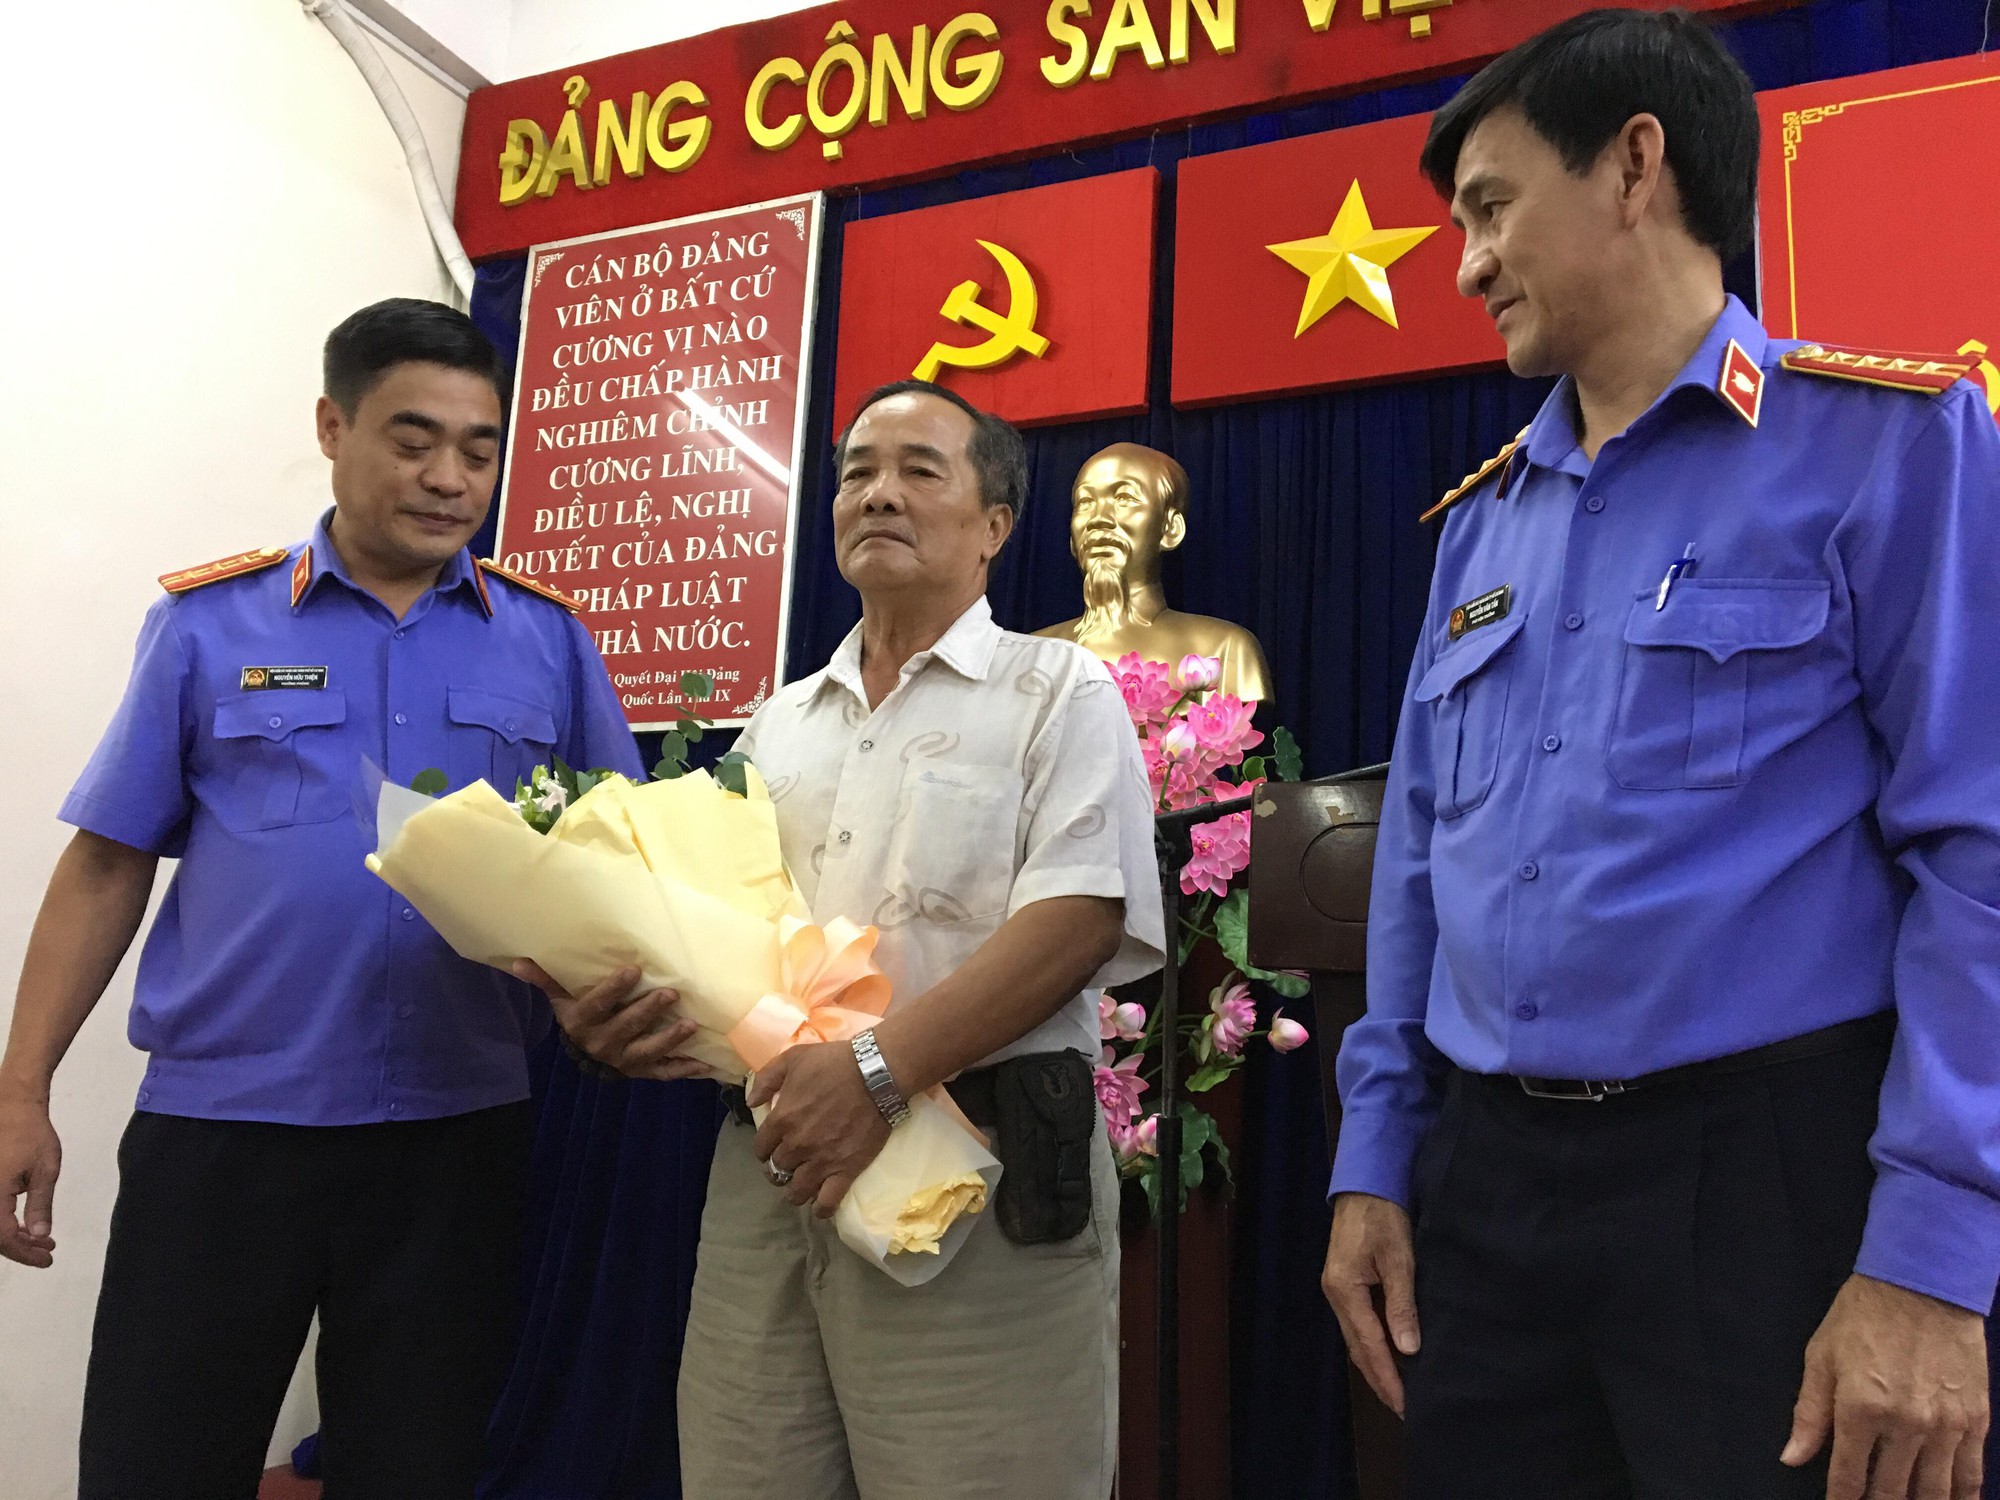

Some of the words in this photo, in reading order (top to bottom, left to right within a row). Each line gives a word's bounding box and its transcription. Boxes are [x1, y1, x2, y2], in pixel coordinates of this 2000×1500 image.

[498, 75, 712, 207] ĐẢNG
[745, 12, 1005, 161] CỘNG
[565, 253, 625, 289] CÁN
[632, 243, 672, 278] BỘ
[681, 230, 770, 268] ĐẢNG
[555, 294, 624, 329] VIÊN
[631, 283, 653, 317] Ở
[659, 271, 722, 313] BẤT
[729, 264, 777, 301] CỨ
[552, 332, 653, 369] CƯƠNG
[663, 326, 693, 355] VỊ
[700, 312, 768, 348] NÀO
[530, 372, 592, 412] ĐỀU
[600, 359, 684, 402] CHẤP
[691, 354, 783, 395] HÀNH
[534, 411, 658, 452] NGHIÊM
[549, 456, 652, 490] CƯƠNG
[660, 444, 745, 479] LĨNH,
[533, 492, 607, 533] ĐIỀU
[613, 491, 661, 528] LỆ,
[671, 487, 753, 521] NGHỊ
[503, 534, 605, 576] QUYẾT
[611, 531, 675, 568] CỦA
[683, 524, 778, 562] ĐẢNG
[571, 577, 653, 614] PHÁP
[659, 570, 748, 609] LUẬT
[652, 615, 750, 653] NƯỚC.
[614, 669, 651, 688] Quyết
[654, 670, 677, 687] Đại
[622, 691, 654, 709] Quốc
[657, 689, 682, 705] Lần
[715, 689, 731, 702] IX
